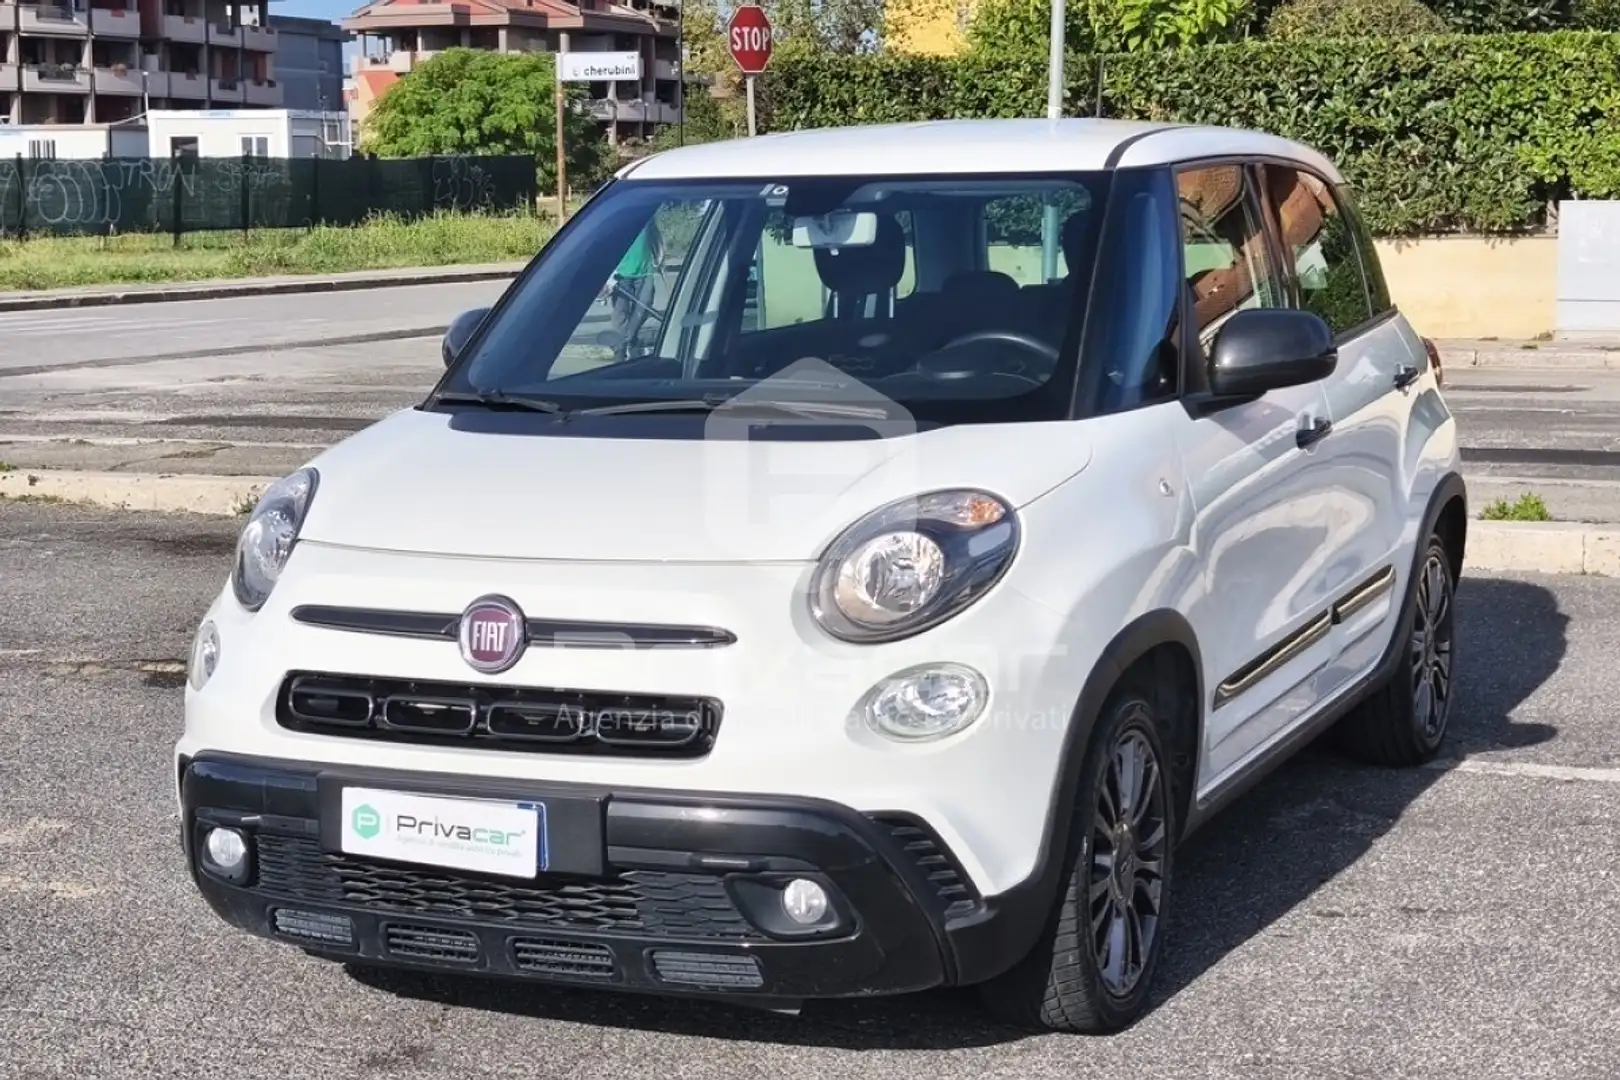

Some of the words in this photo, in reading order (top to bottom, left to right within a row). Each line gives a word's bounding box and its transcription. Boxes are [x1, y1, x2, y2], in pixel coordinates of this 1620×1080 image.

[731, 26, 770, 51] STOP
[583, 64, 635, 76] cherubini
[471, 620, 509, 652] FIAT
[396, 814, 523, 845] Privacar
